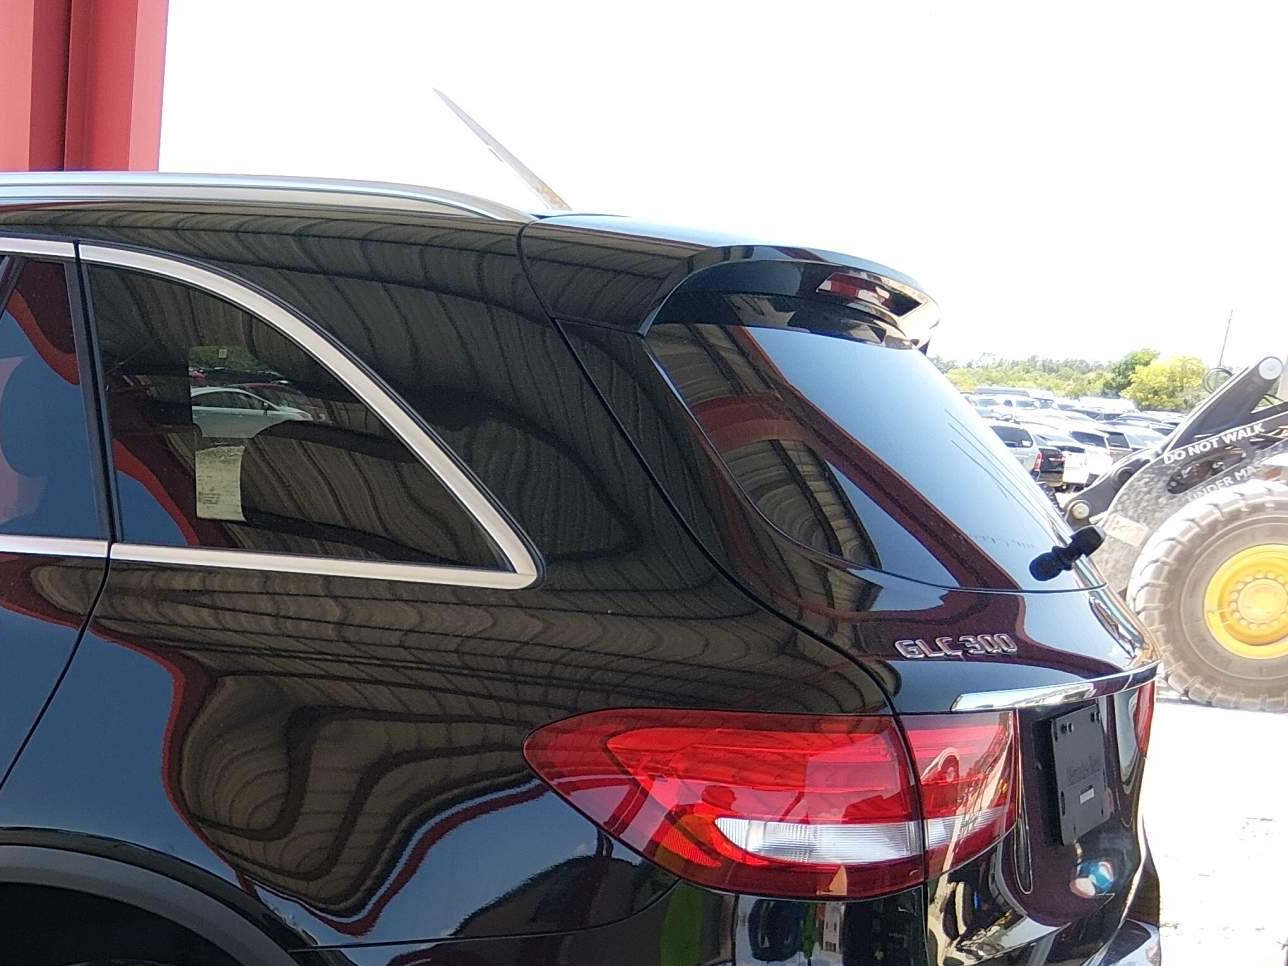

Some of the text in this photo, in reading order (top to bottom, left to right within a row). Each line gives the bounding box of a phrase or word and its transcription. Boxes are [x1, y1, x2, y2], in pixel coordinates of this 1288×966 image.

[1163, 422, 1265, 464] DO NOT WALK
[894, 633, 1018, 659] GLC 300
